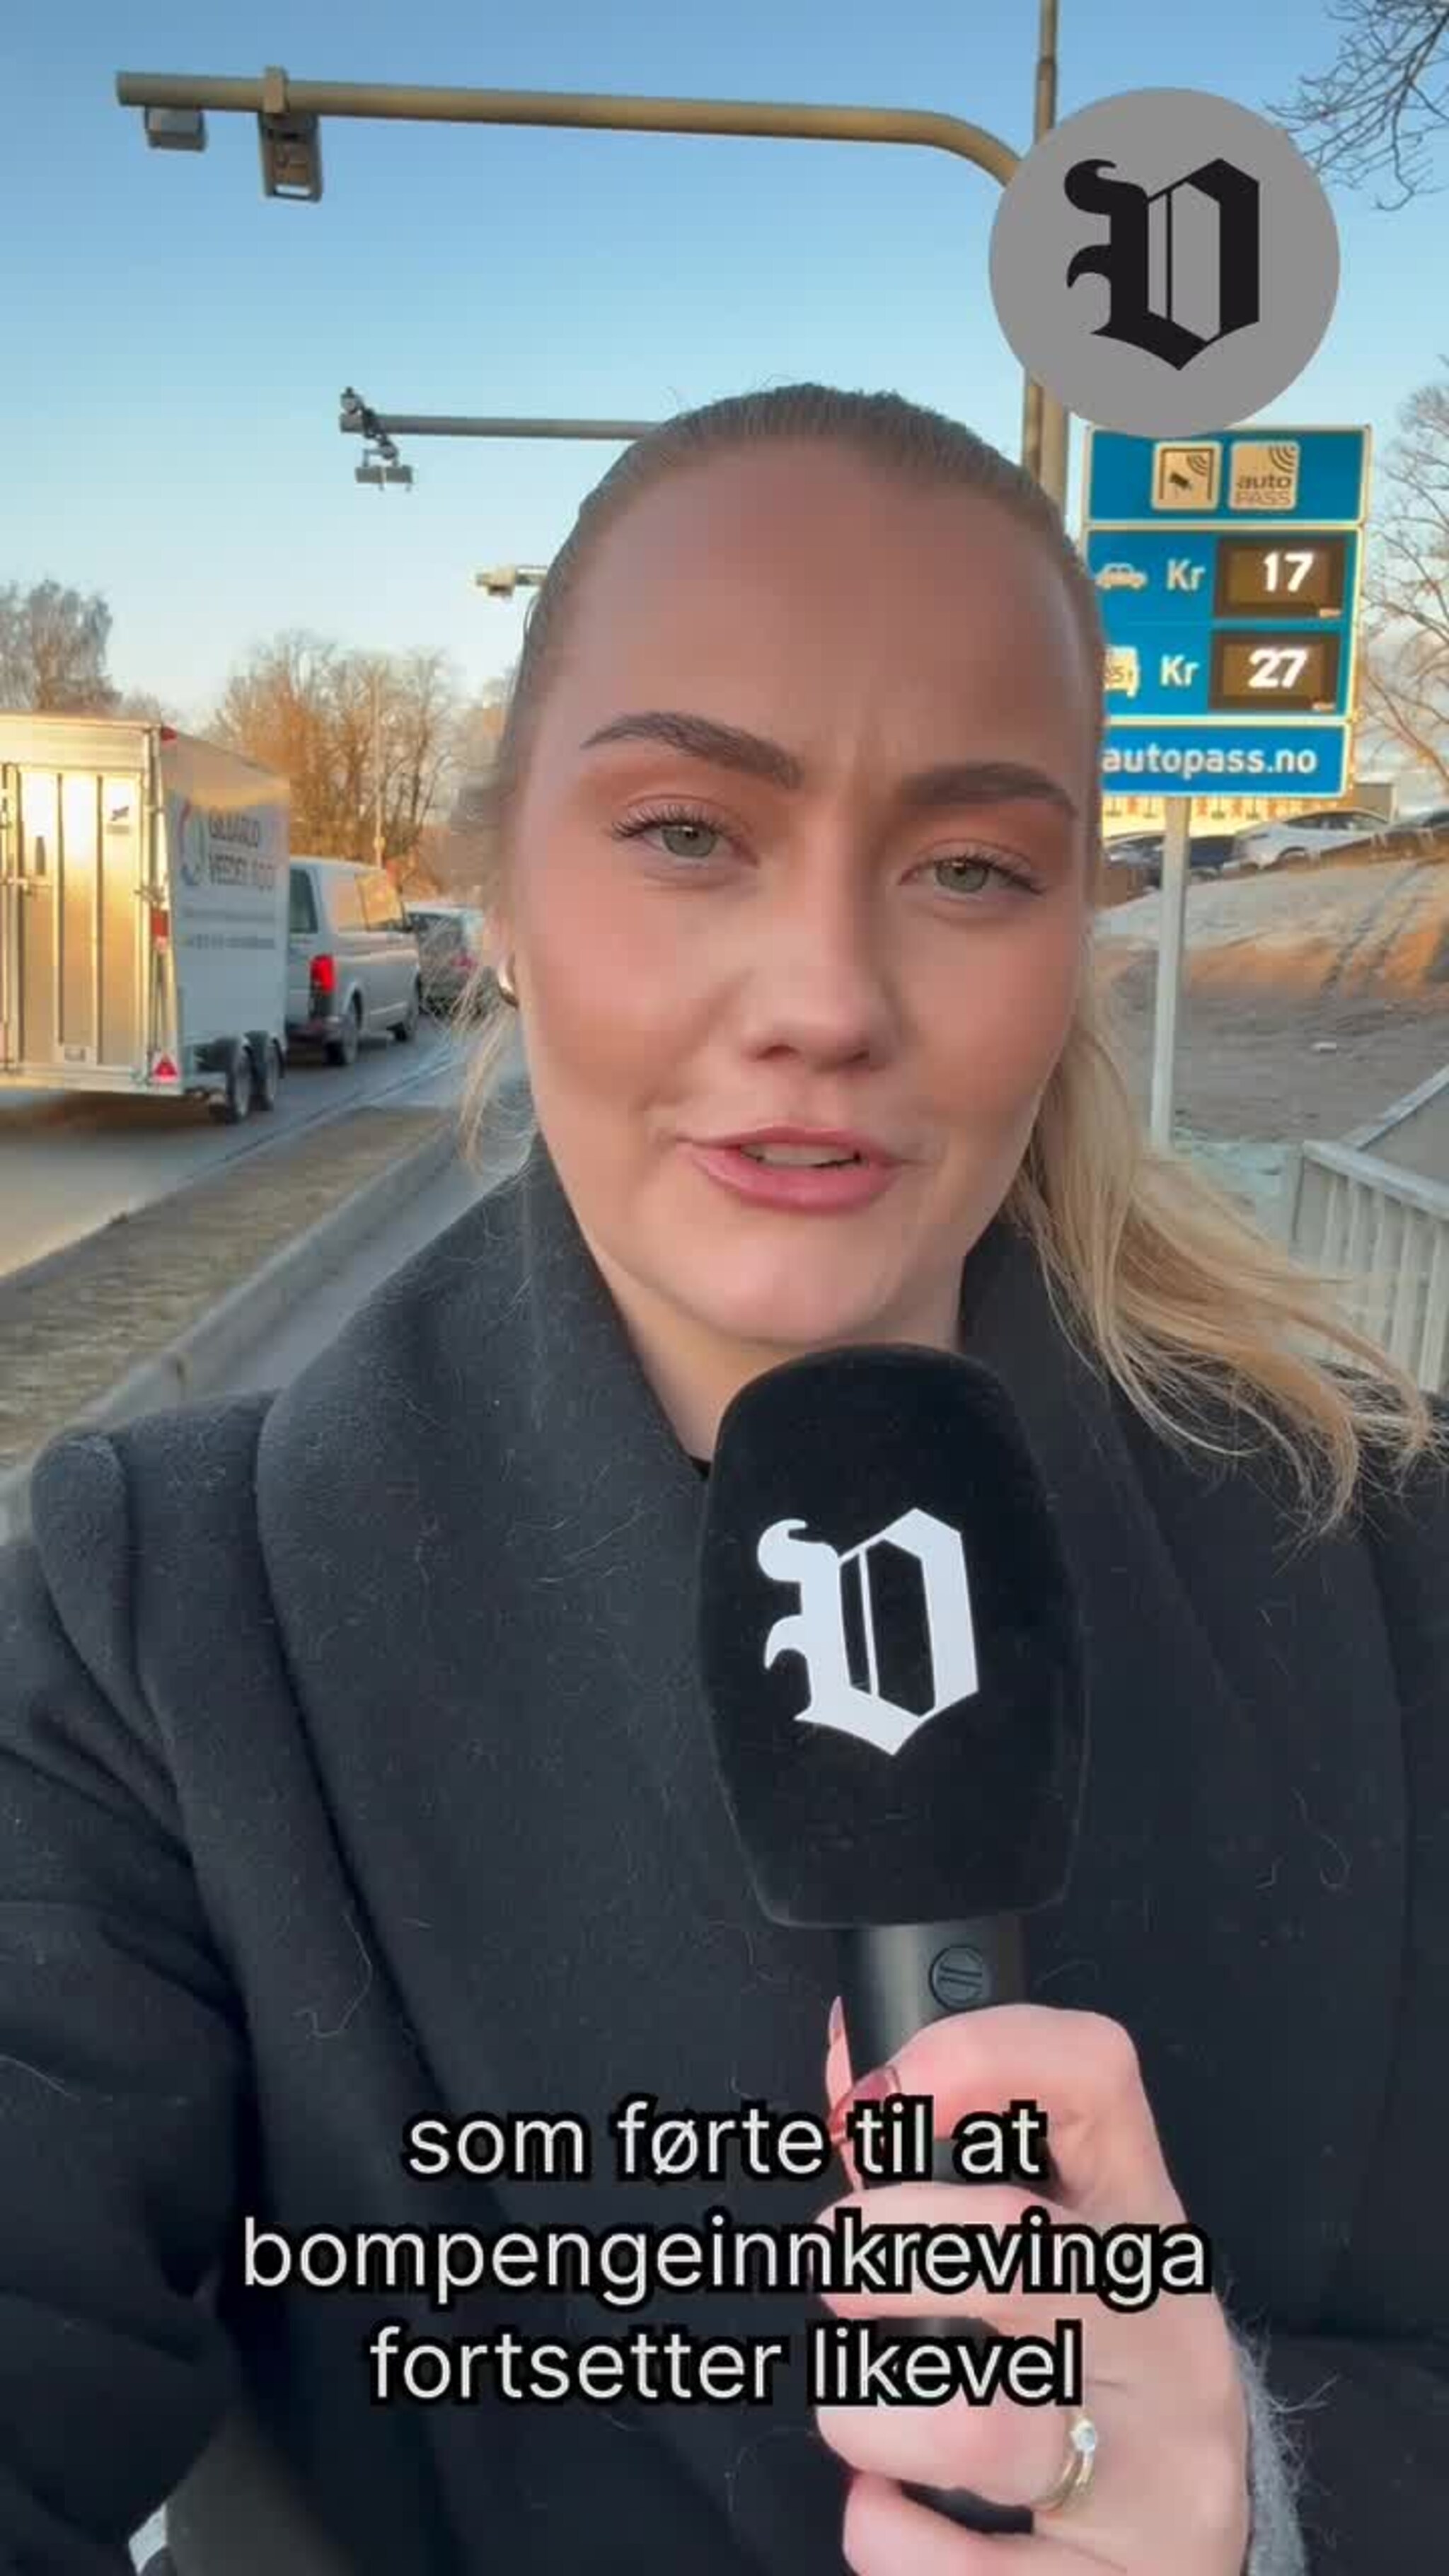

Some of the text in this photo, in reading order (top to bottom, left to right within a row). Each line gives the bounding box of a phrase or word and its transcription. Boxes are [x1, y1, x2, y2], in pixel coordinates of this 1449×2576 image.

[1236, 474, 1291, 490] auto
[1166, 551, 1315, 592] Kr 17
[1160, 654, 1200, 687] Kr
[1247, 647, 1307, 689] 27
[1101, 742, 1317, 780] autopass.no
